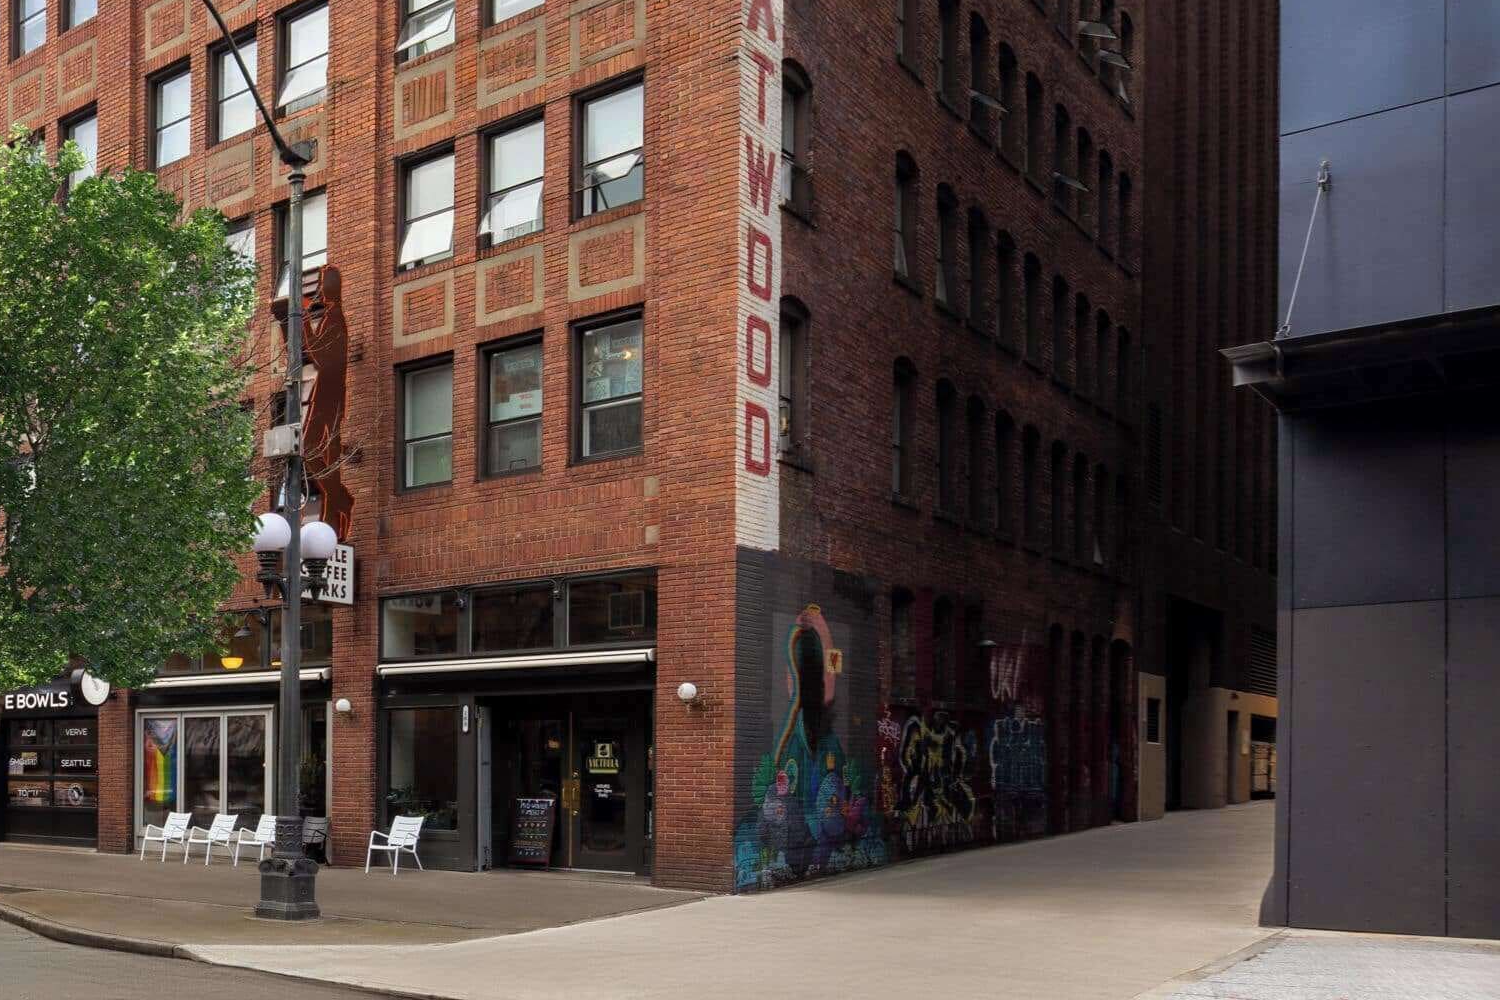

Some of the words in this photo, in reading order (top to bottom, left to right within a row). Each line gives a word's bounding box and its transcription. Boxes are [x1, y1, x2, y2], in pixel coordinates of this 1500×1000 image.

[300, 560, 348, 581] CFEE
[16, 691, 68, 709] BOWLS
[65, 728, 88, 736] VERVE
[60, 759, 92, 767] SEATTLE
